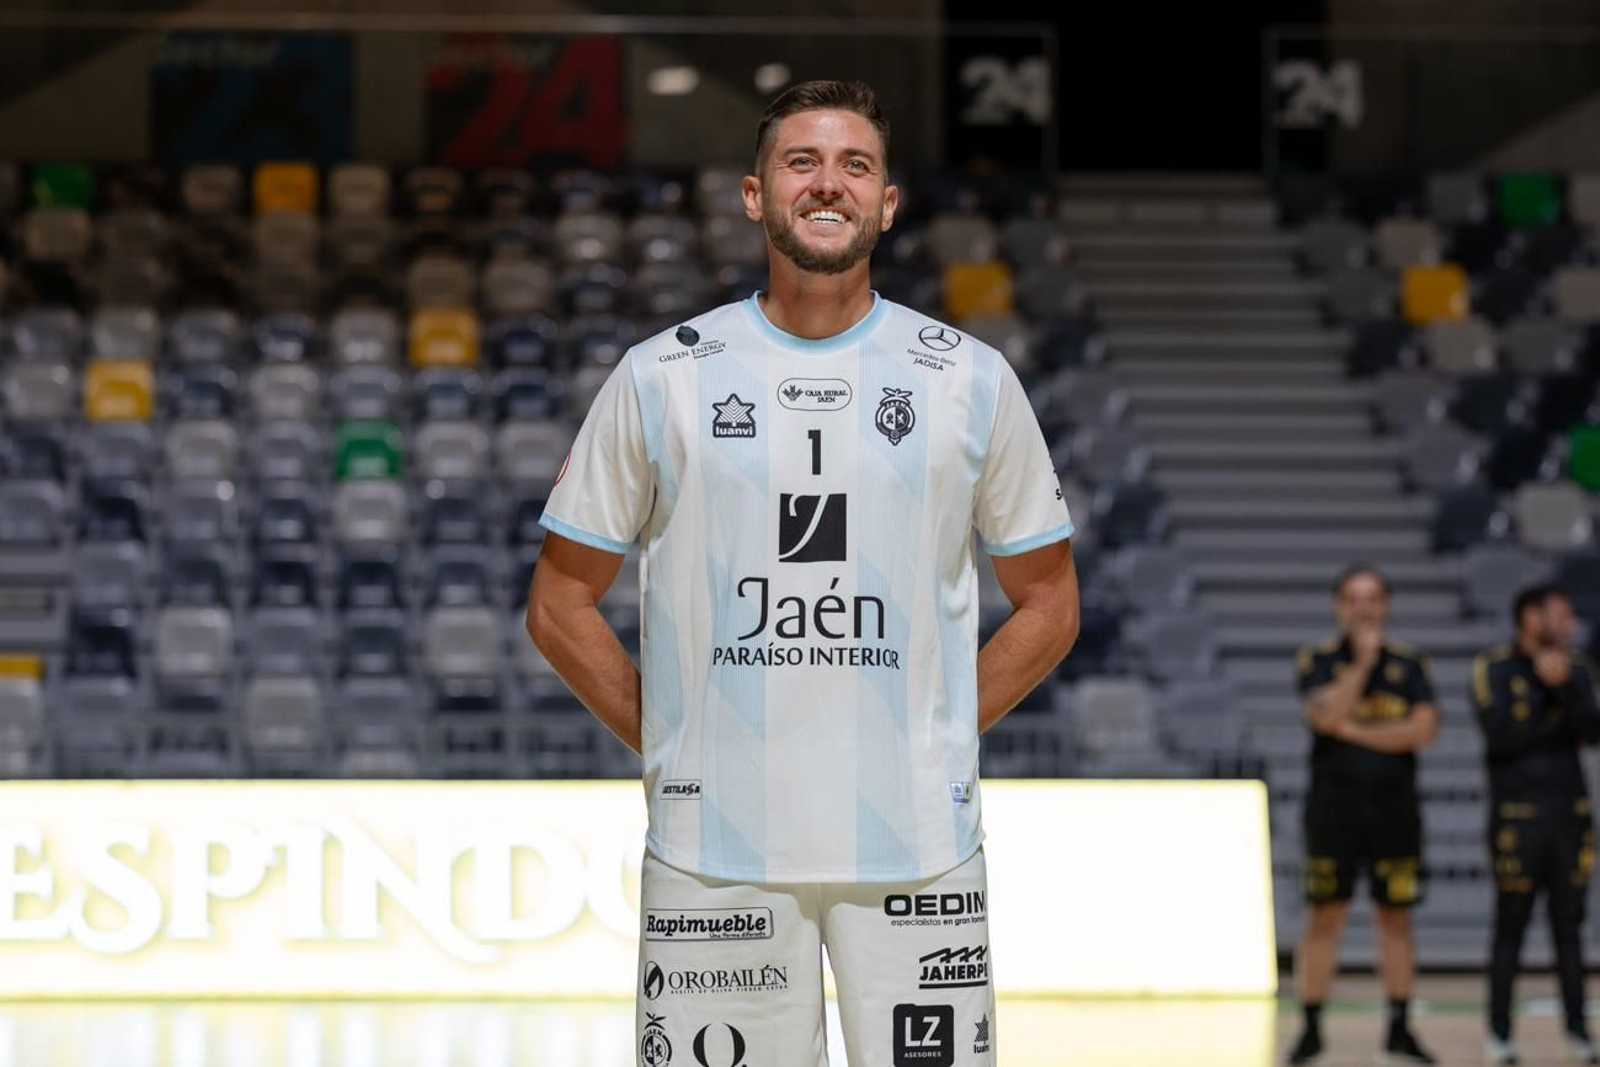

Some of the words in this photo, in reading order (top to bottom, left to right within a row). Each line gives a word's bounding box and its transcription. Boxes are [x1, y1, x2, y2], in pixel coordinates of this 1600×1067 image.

[962, 55, 1051, 127] 24
[1272, 58, 1363, 129] 24
[659, 349, 690, 362] GREEN
[691, 341, 727, 356] ENERGY
[913, 357, 945, 371] JADISA
[804, 389, 823, 397] CAJA
[823, 389, 849, 397] RURAL
[714, 425, 754, 436] luanvi
[807, 429, 822, 476] 1
[737, 576, 885, 641] Jaén
[713, 642, 803, 667] PARAÍSO
[809, 646, 900, 670] INTERIOR
[646, 913, 766, 937] Rapimueble
[891, 917, 941, 927] especialistas
[943, 917, 953, 925] en
[954, 916, 971, 926] gran
[668, 964, 788, 990] OROBAILÉN
[905, 1015, 942, 1047] LZ
[903, 1050, 942, 1058] ASESORES
